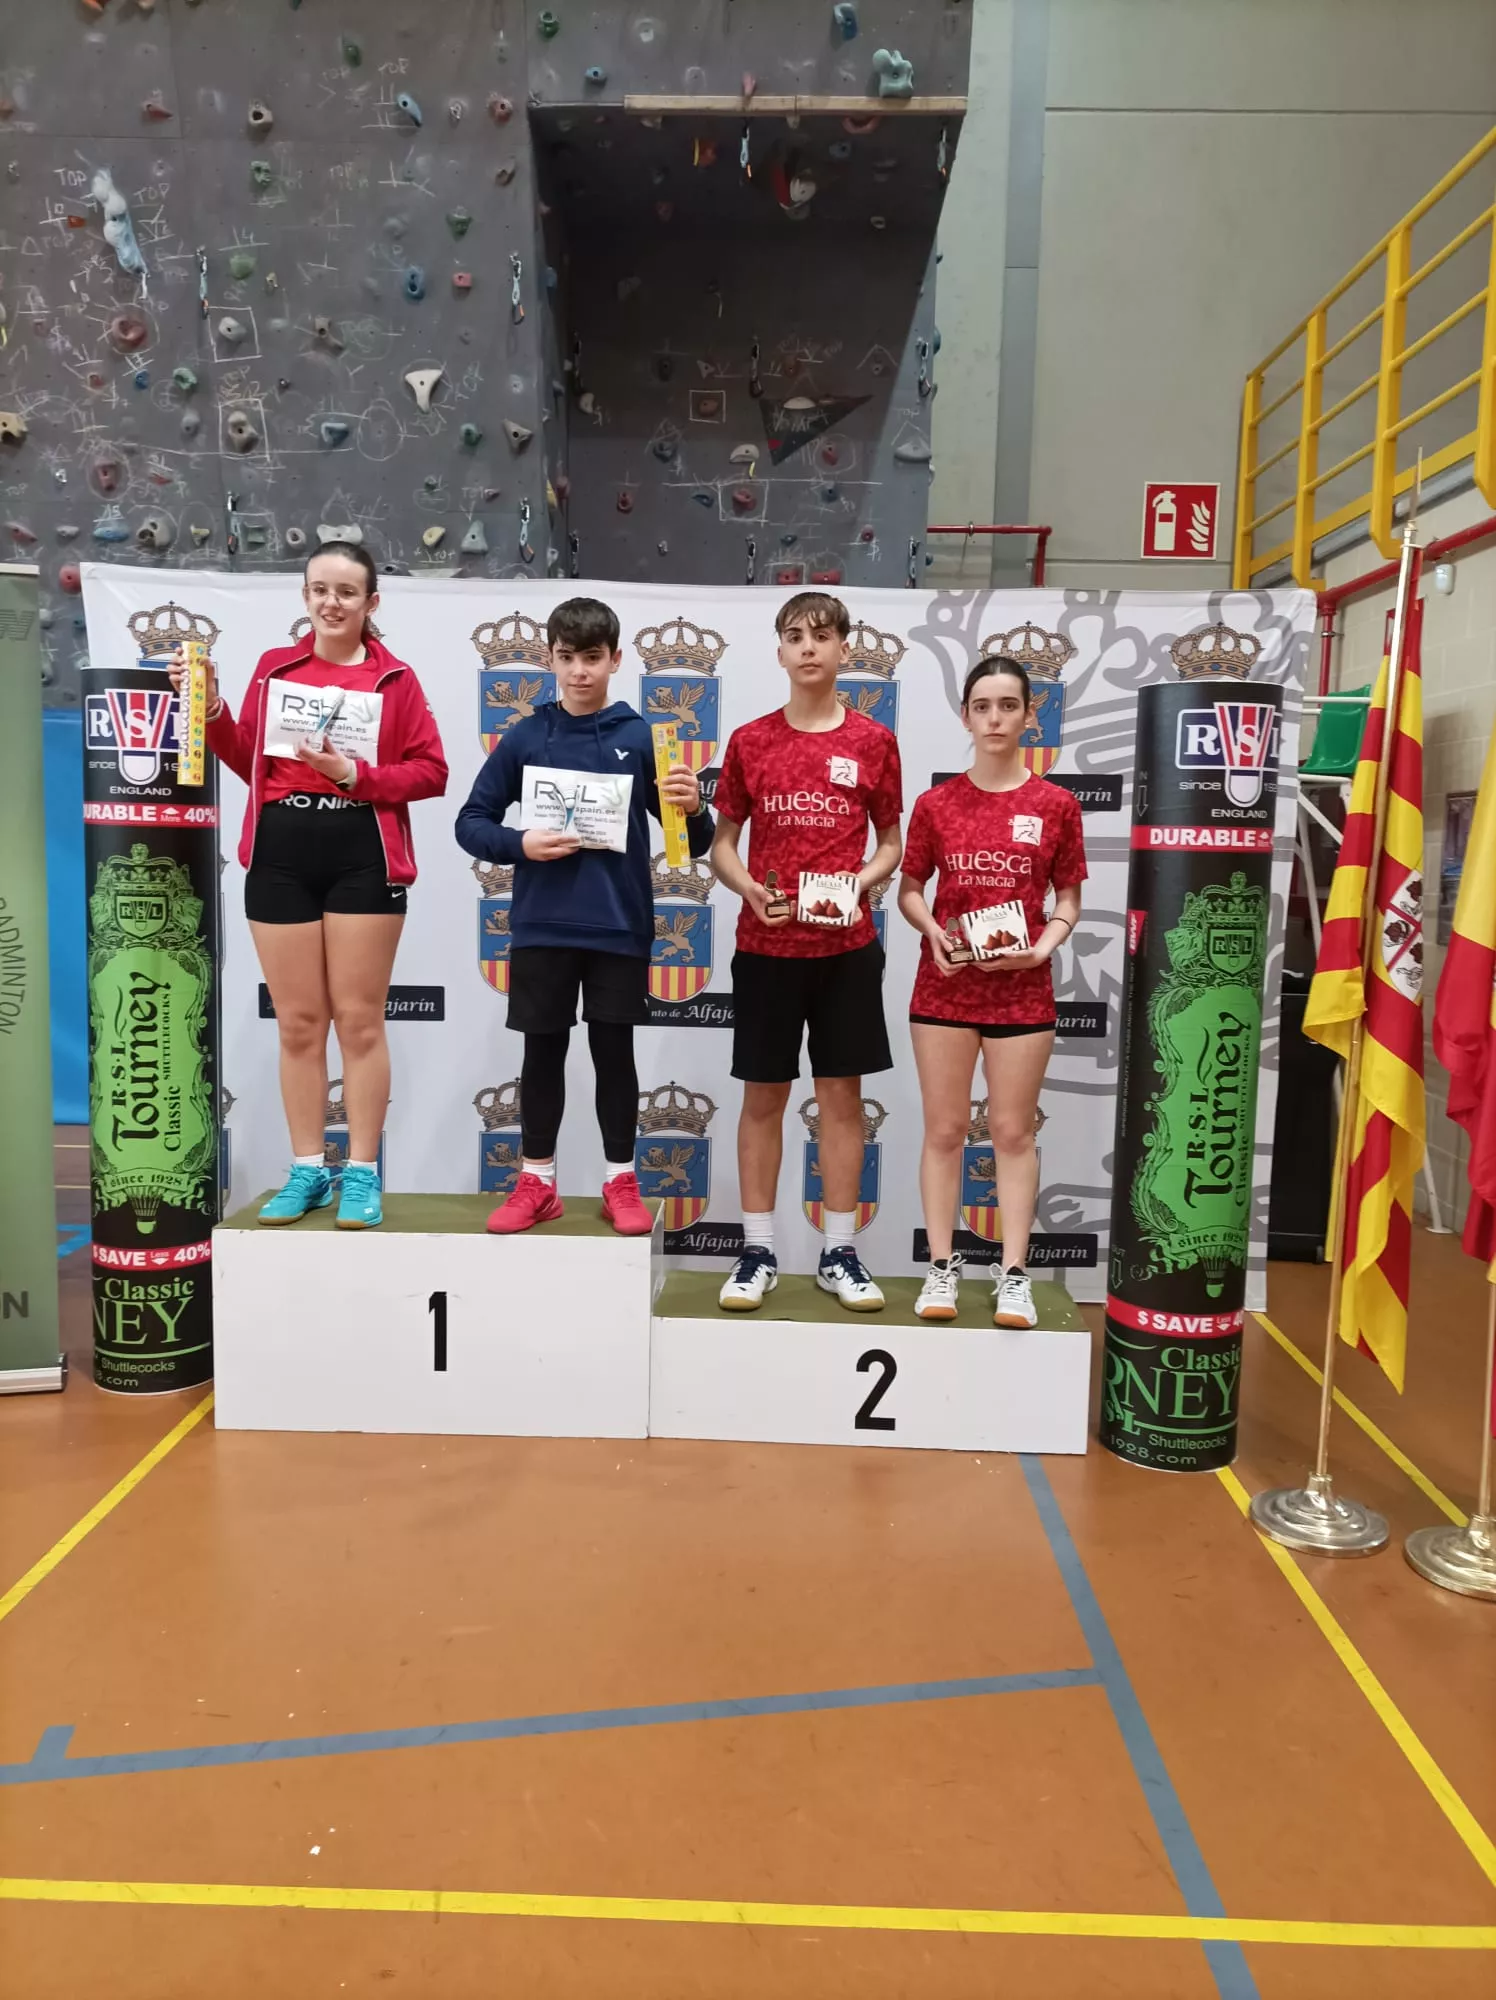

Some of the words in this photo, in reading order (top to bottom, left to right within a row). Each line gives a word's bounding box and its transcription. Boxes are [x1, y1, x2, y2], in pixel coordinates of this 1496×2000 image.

[109, 785, 172, 797] ENGLAND
[534, 780, 597, 803] RL
[1179, 780, 1221, 791] since
[316, 796, 370, 810] NIK
[1211, 808, 1268, 819] ENGLAND
[184, 807, 217, 823] 40%
[1150, 827, 1256, 847] DURABLE
[0, 897, 27, 1035] ADMINTON
[669, 1008, 681, 1018] de
[111, 971, 172, 1152] Tourney
[163, 1085, 182, 1152] Classic
[1183, 1010, 1252, 1209] Tourney
[1235, 1135, 1250, 1207] Classic
[99, 1247, 147, 1267] SAVE
[174, 1242, 211, 1263] 40%
[104, 1277, 195, 1300] Classic
[428, 1291, 448, 1372] 1
[1137, 1310, 1148, 1326] $
[1152, 1313, 1213, 1333] SAVE
[101, 1357, 176, 1374] Shuttlecocks
[854, 1349, 897, 1430] 2
[1111, 1434, 1197, 1465] 1928.com
[1148, 1433, 1228, 1451] Shuttlecocks
